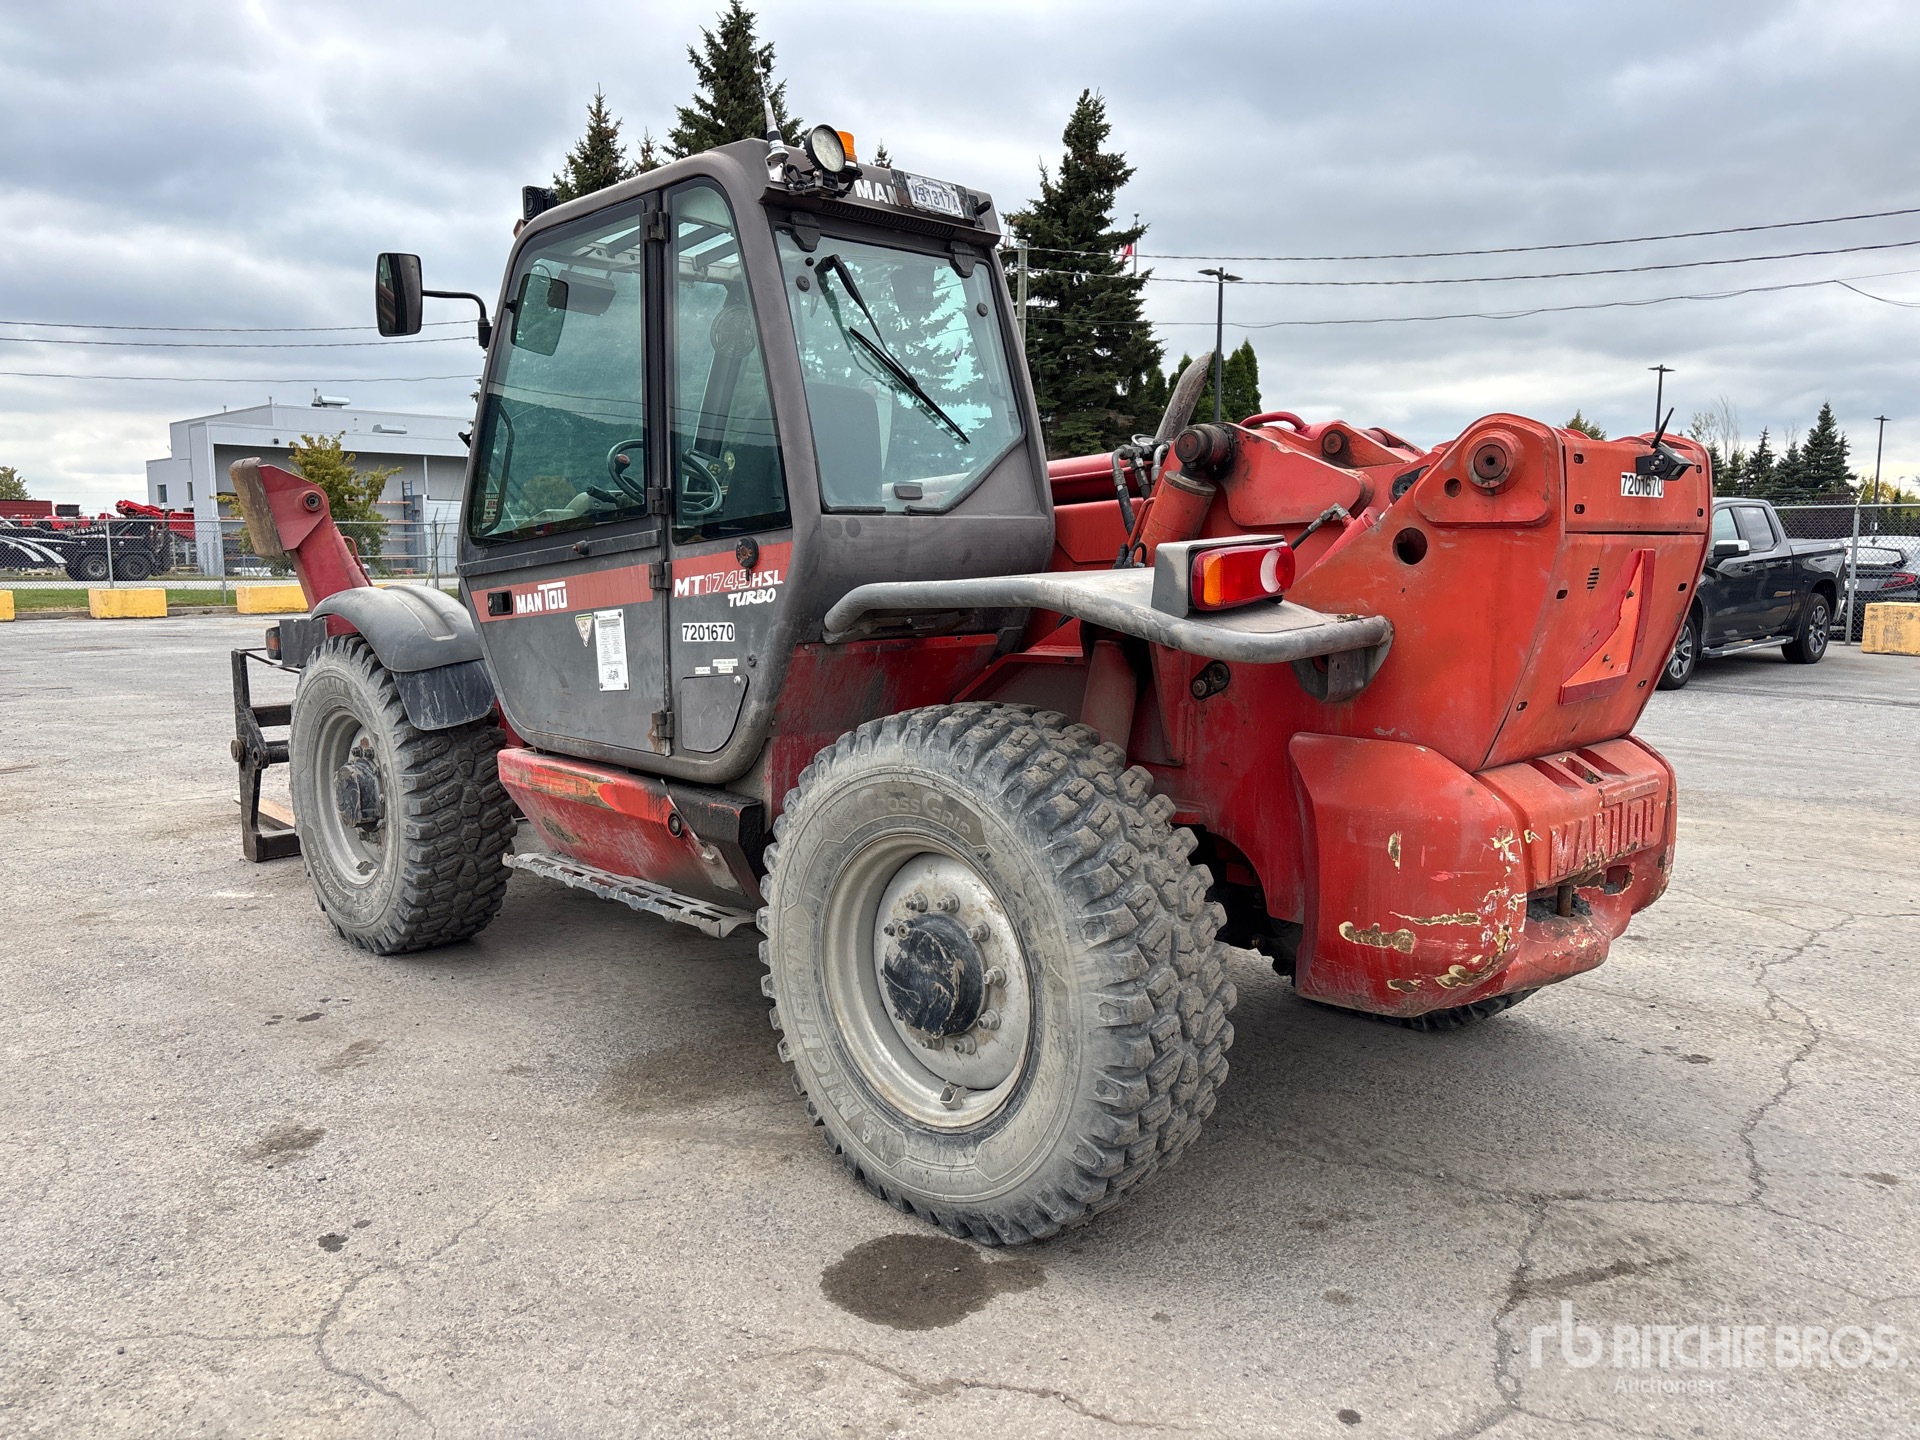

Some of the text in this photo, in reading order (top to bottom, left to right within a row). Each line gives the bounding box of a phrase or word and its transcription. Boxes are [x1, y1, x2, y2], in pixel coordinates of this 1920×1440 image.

[1621, 474, 1663, 496] 7201670
[727, 587, 777, 607] TURBO
[682, 624, 734, 641] 7201670
